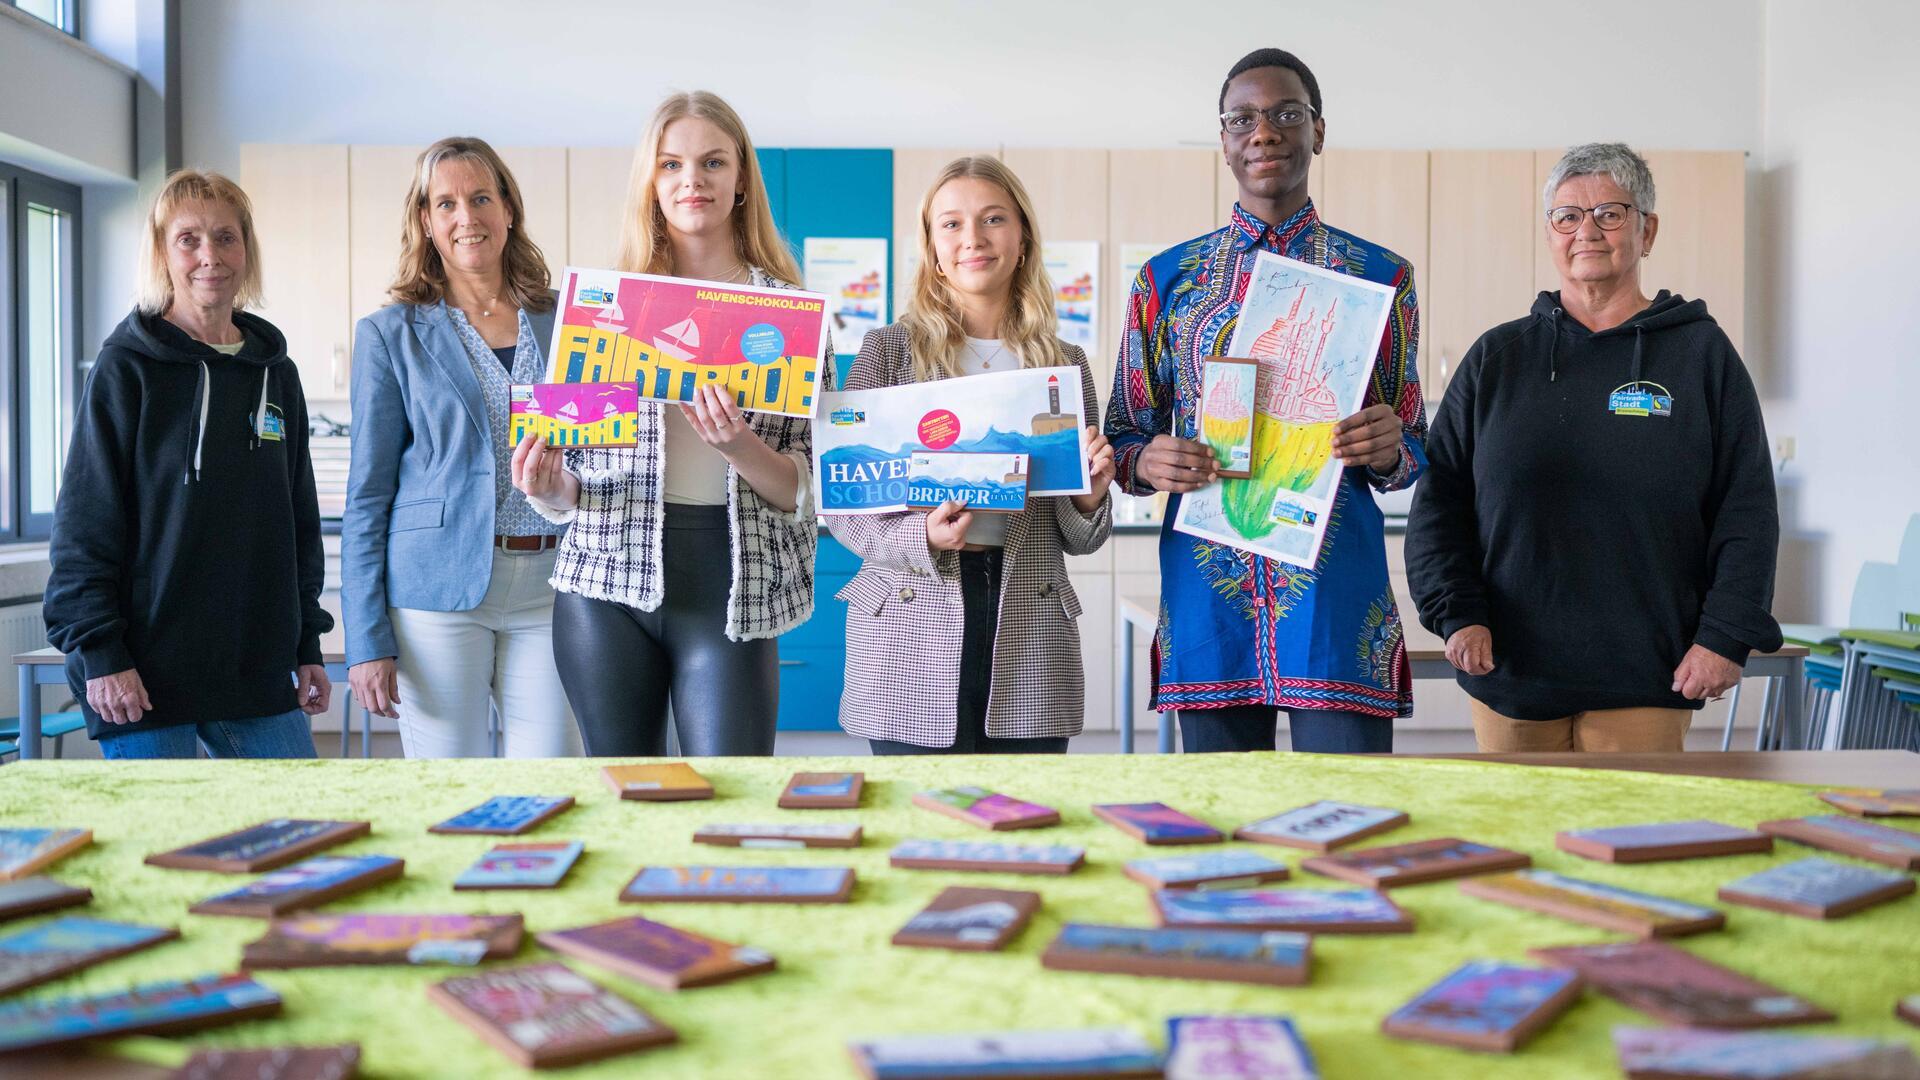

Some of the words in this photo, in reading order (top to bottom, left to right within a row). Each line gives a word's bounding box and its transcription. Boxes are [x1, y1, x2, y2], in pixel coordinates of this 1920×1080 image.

[696, 289, 822, 312] HAVENSCHOKOLADE
[1611, 400, 1641, 408] Stadt
[509, 411, 638, 447] FAIRTRADE
[830, 480, 906, 505] SCHO
